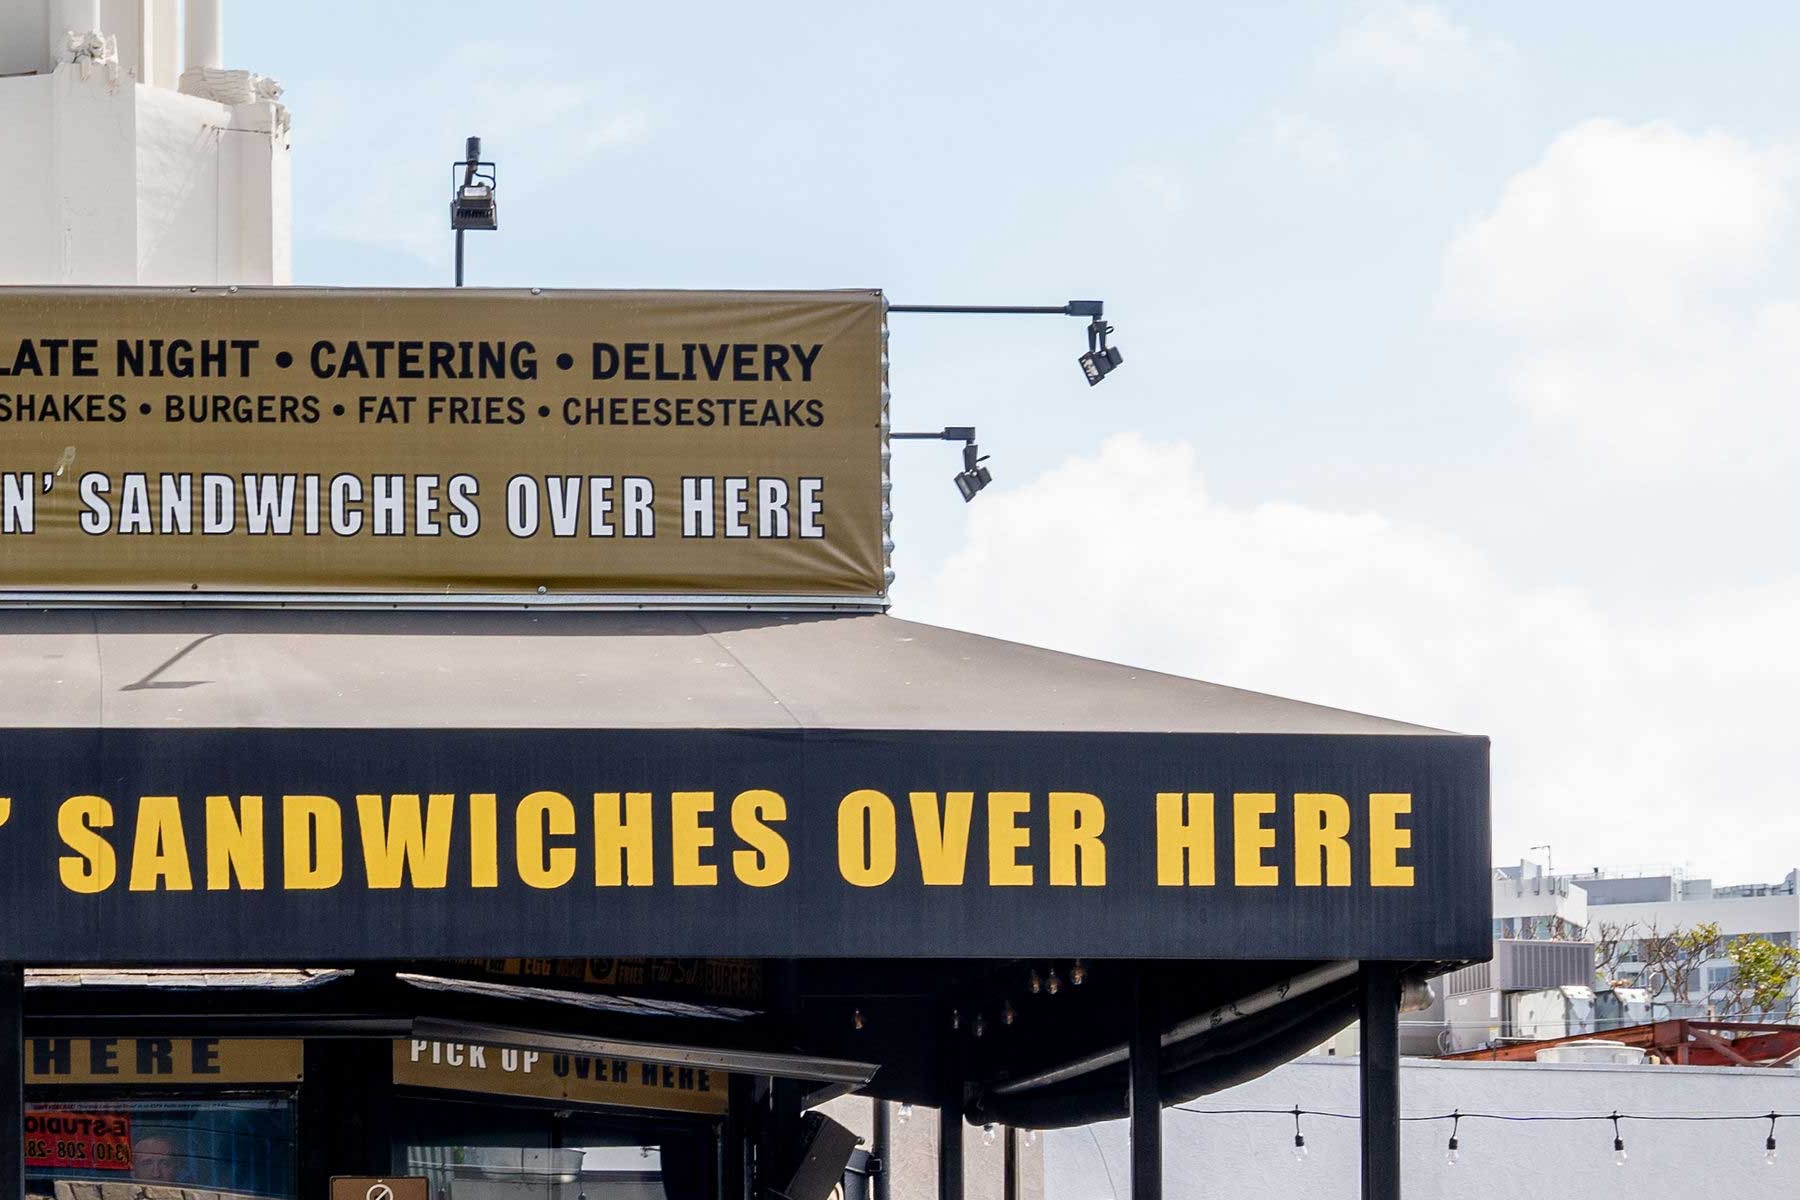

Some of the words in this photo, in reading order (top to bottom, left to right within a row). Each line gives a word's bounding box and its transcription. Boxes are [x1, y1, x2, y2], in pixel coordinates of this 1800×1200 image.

[117, 338, 259, 378] NIGHT
[309, 341, 538, 379] CATERING
[592, 343, 823, 381] DELIVERY
[166, 395, 320, 424] BURGERS
[358, 396, 413, 424] FAT
[428, 397, 526, 425] FRIES
[562, 398, 825, 427] CHEESESTEAKS
[78, 471, 481, 538] SANDWICHES
[505, 475, 656, 539] OVER
[681, 476, 826, 539] HERE
[58, 788, 790, 893] SANDWICHES
[837, 789, 1107, 888] OVER
[1156, 792, 1415, 888] HERE
[33, 1038, 222, 1075] HERE
[411, 1040, 486, 1068] PICK
[502, 1050, 539, 1073] UP
